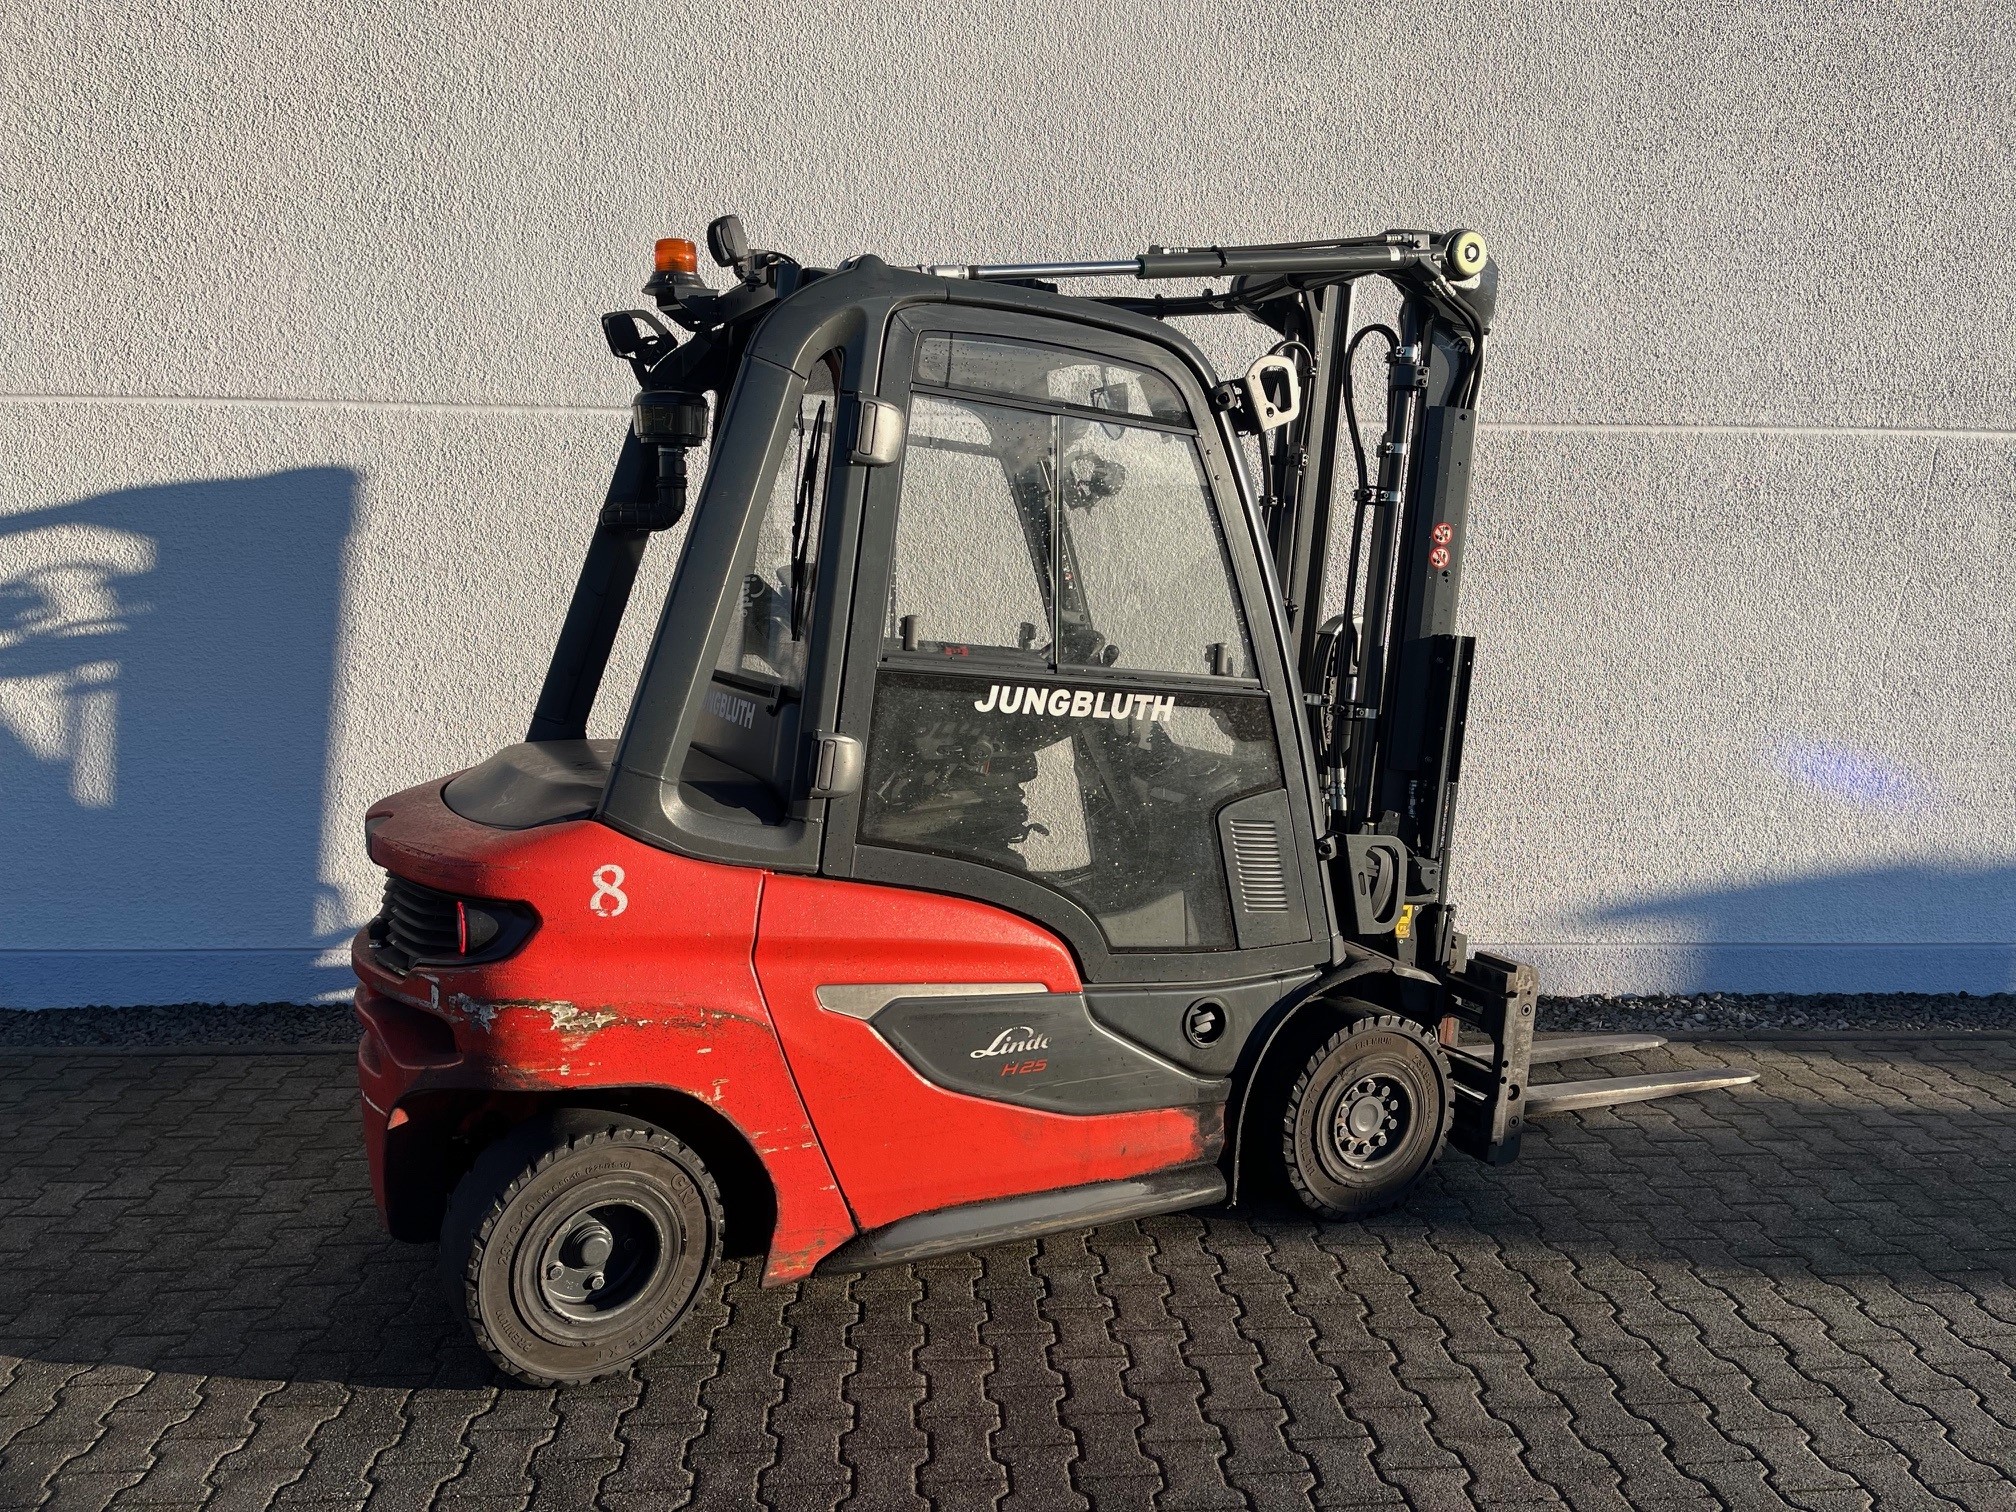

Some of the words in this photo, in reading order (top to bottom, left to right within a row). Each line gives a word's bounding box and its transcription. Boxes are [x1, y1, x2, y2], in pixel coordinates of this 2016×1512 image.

[974, 685, 1176, 722] JUNGBLUTH
[589, 863, 629, 918] 8
[969, 1026, 1053, 1059] Linde
[1354, 1036, 1393, 1050] PREMIUM
